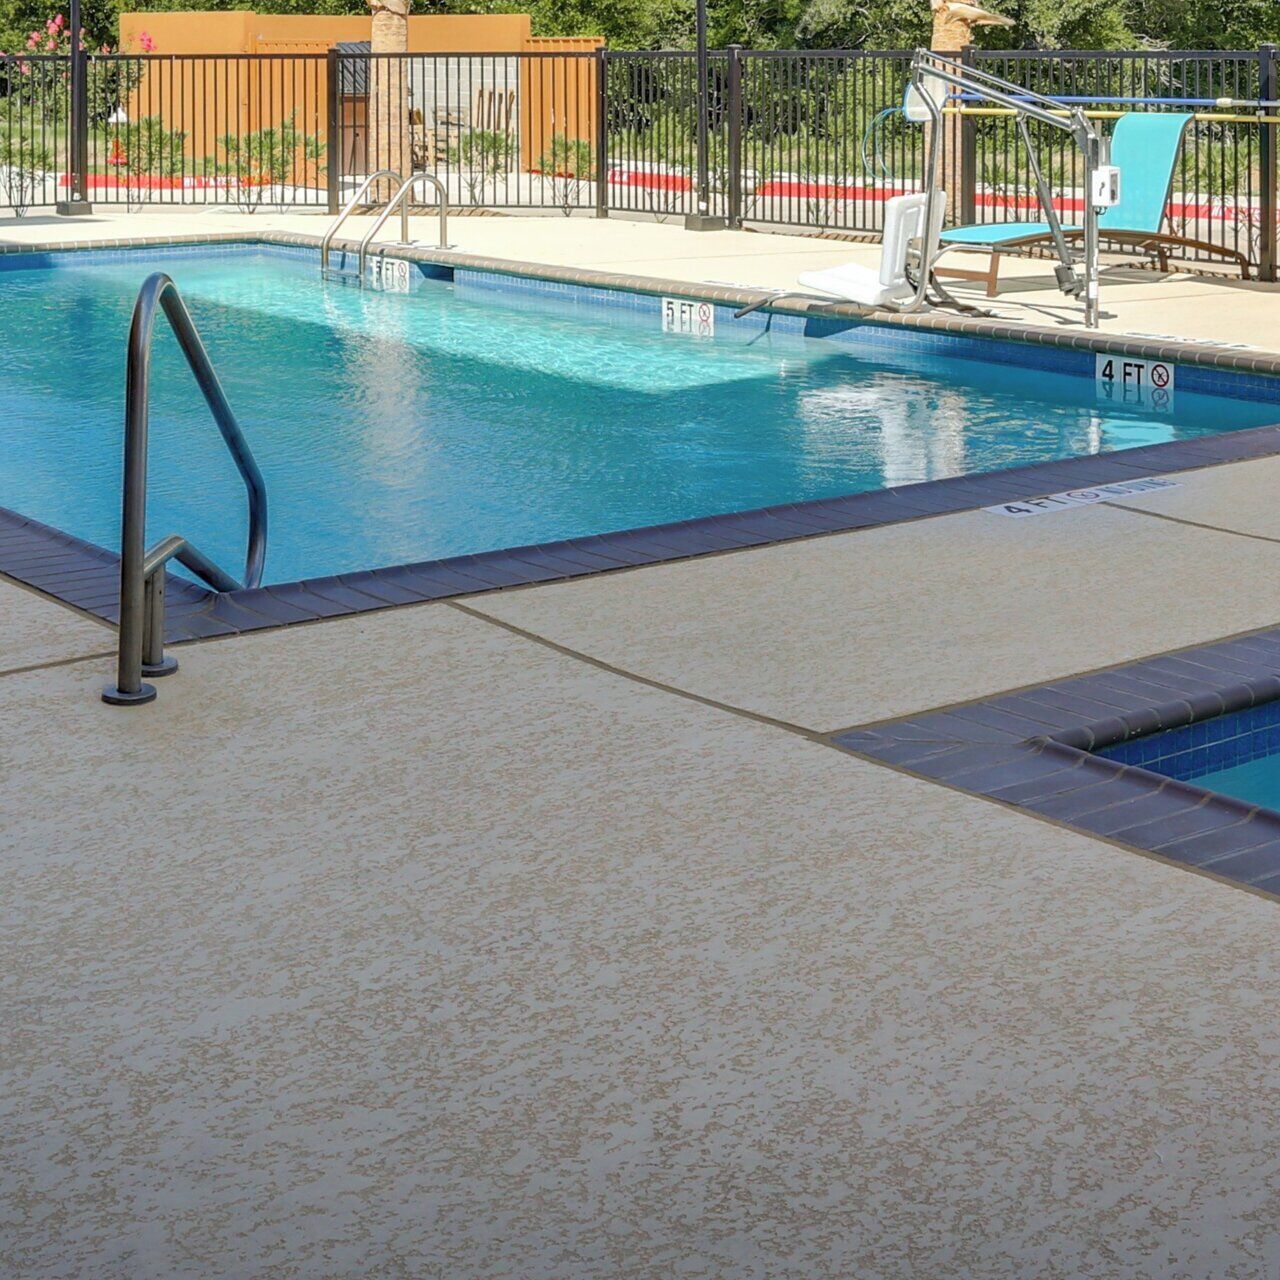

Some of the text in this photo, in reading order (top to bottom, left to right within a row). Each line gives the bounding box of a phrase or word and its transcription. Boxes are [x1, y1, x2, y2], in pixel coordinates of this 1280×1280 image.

[666, 301, 694, 320] 5 FT
[1102, 359, 1145, 385] 4 FT
